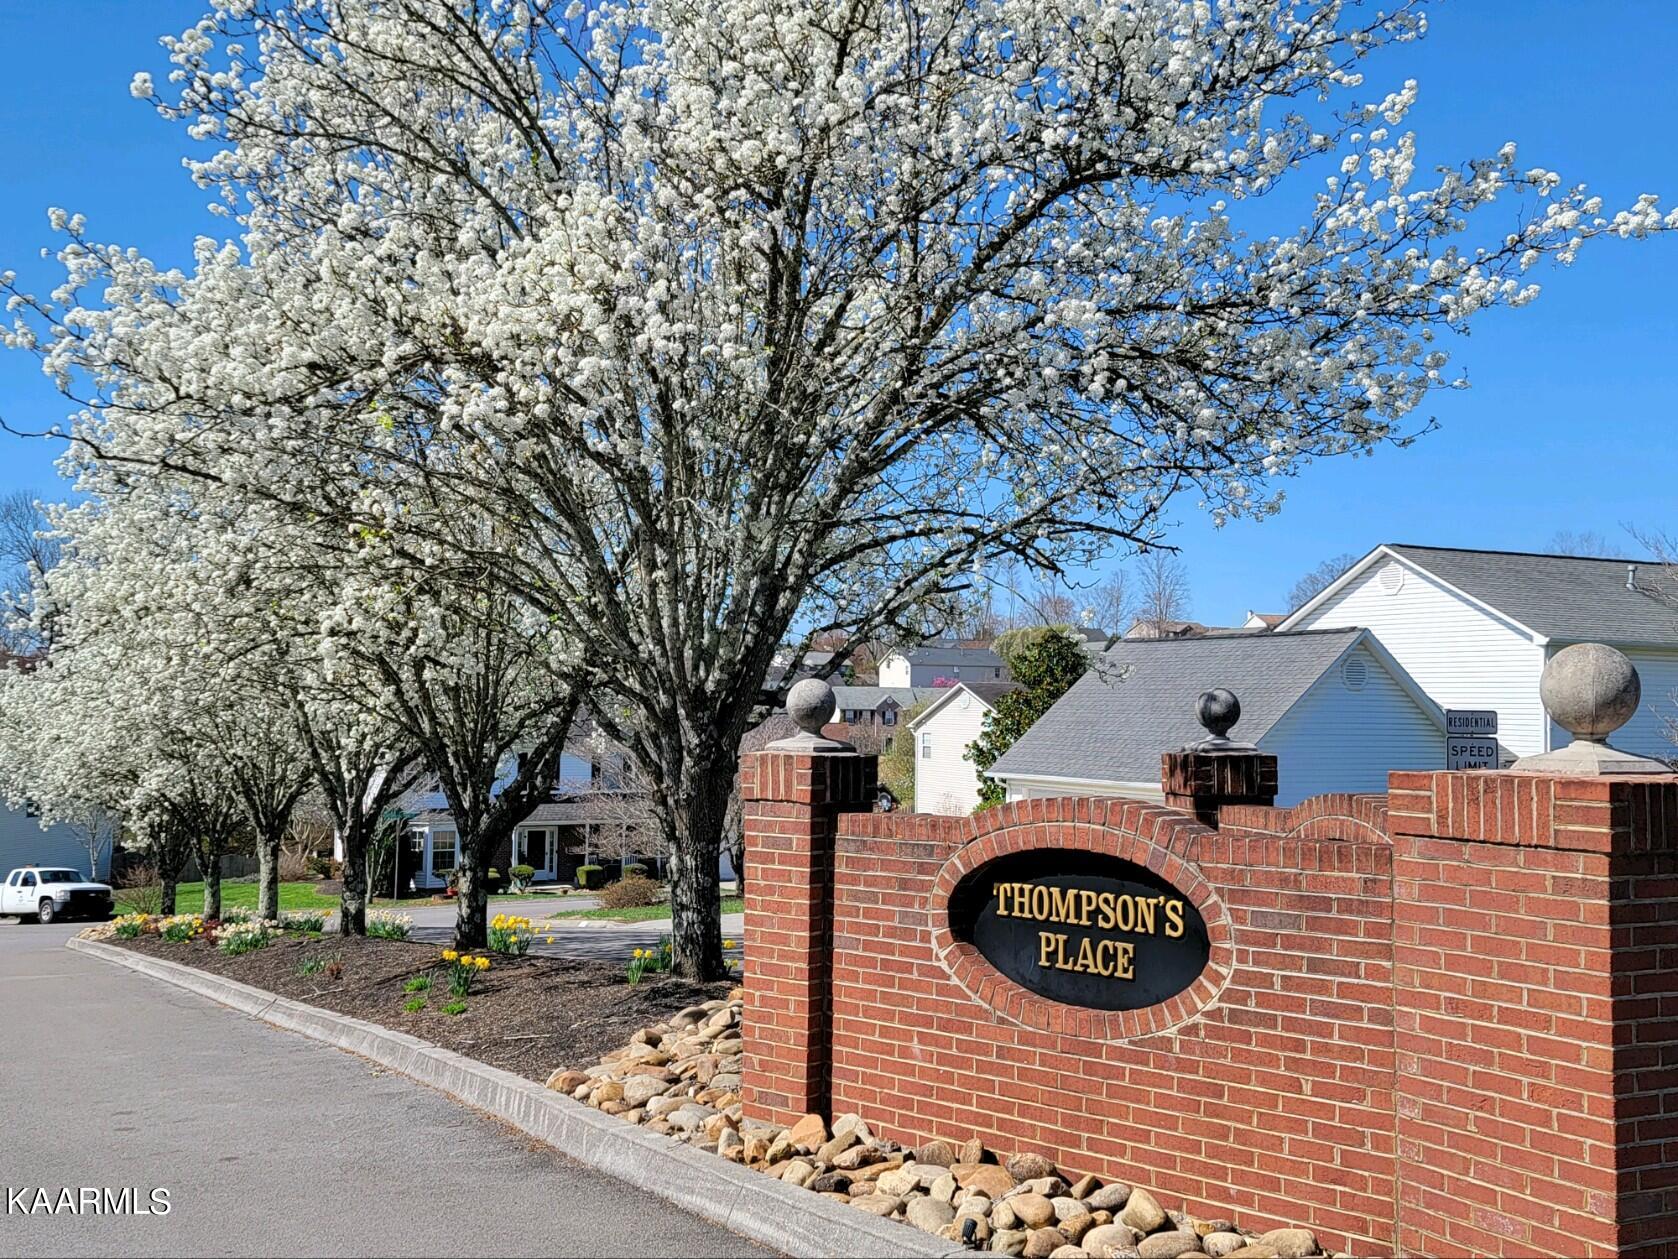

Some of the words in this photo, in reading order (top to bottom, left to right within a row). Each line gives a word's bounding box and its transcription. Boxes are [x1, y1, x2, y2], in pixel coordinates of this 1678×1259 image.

[1449, 717, 1495, 727] RESIDENTIAL
[1451, 745, 1494, 757] SPEED
[1455, 760, 1488, 770] LIMIT
[994, 882, 1184, 938] THOMPSON'S
[1038, 932, 1134, 979] PLACE
